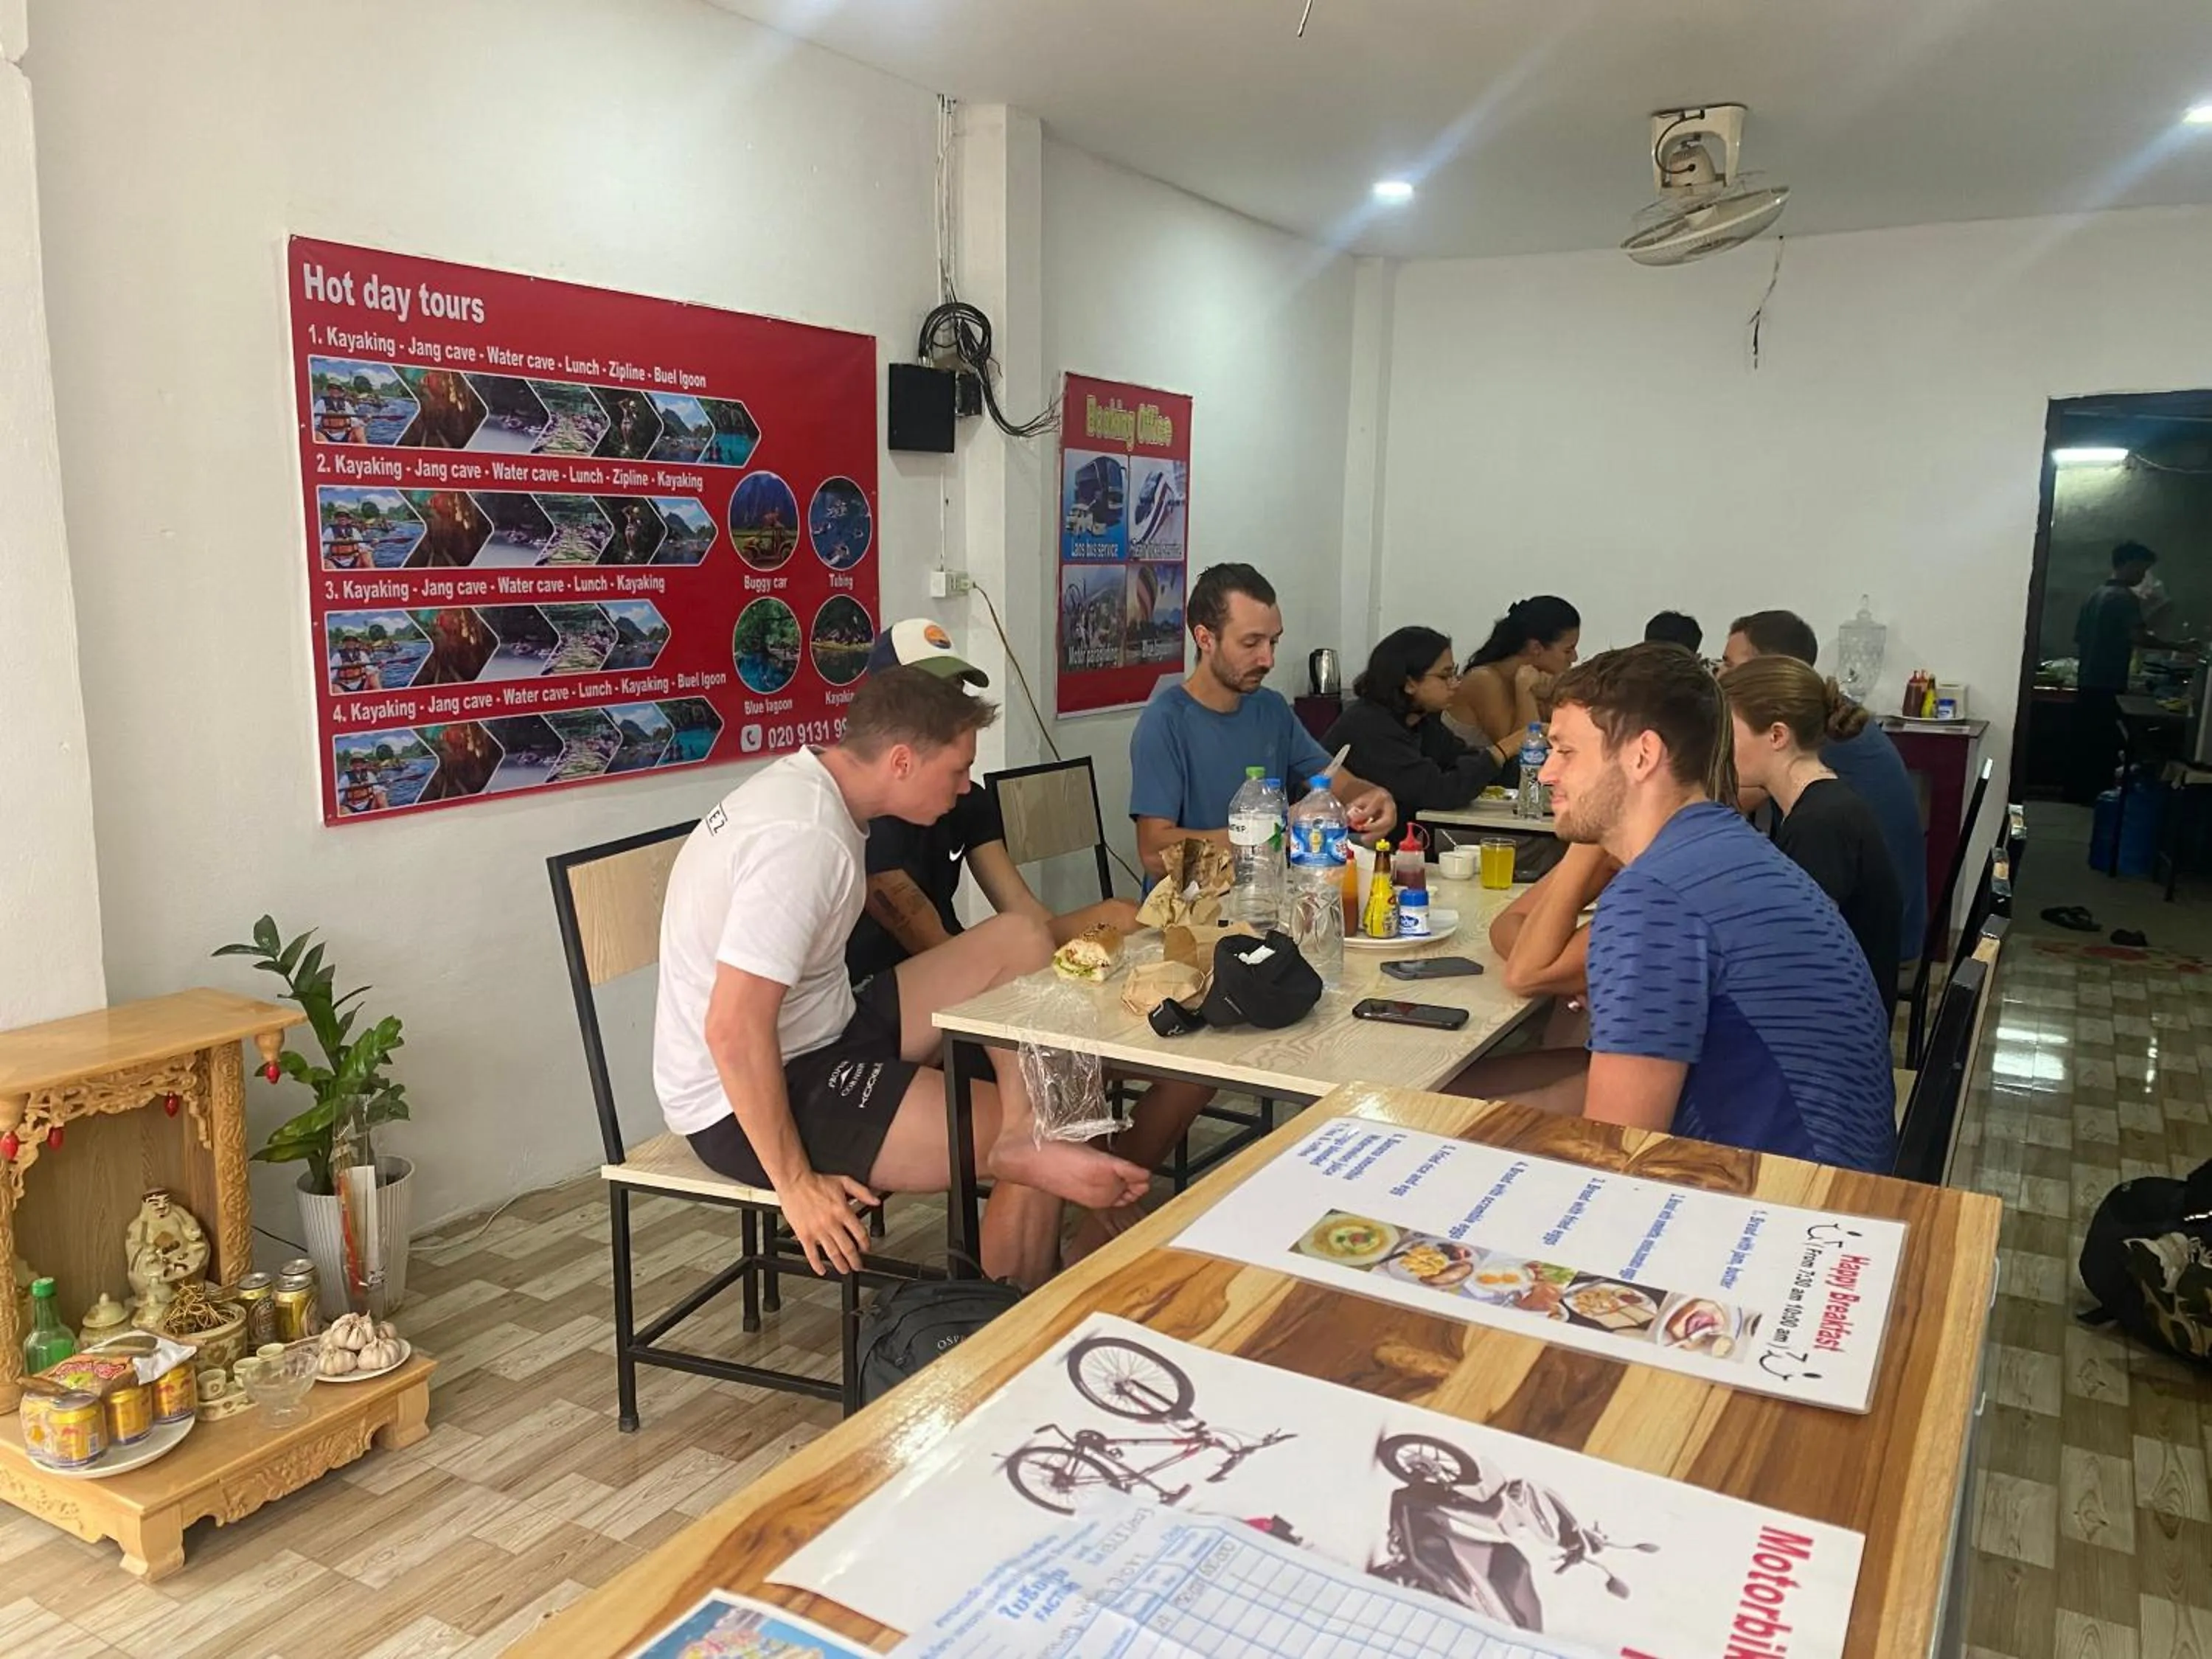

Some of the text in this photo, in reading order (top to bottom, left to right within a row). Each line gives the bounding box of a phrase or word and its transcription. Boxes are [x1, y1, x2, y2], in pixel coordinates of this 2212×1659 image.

[303, 262, 484, 323] Hot day tours
[308, 324, 322, 346] 1.
[327, 327, 395, 357] Kayaking
[408, 337, 441, 362] Jang
[445, 345, 476, 362] cave
[487, 347, 524, 367] Water
[527, 352, 555, 371] cave
[566, 356, 599, 375] Lunch
[609, 361, 645, 384] Zipline
[654, 367, 677, 385] Buel
[316, 454, 330, 473] 2.
[335, 456, 402, 479] Kayaking
[414, 459, 448, 481] Jang
[451, 465, 481, 479] cave
[492, 462, 528, 480] Water
[532, 467, 560, 482] cave
[568, 466, 603, 484] Lunch
[613, 468, 648, 488] Zipline
[657, 471, 703, 492] Kayaking
[325, 580, 338, 599] 3.
[343, 580, 409, 603] Kayaking
[421, 579, 453, 599] Jang
[457, 580, 487, 596] cave
[498, 576, 534, 594] Water
[537, 579, 564, 593] cave
[574, 575, 608, 591] Lunch
[616, 574, 664, 594] Kayaking
[744, 575, 788, 593] Buggy car
[829, 574, 854, 590] Tubing
[333, 705, 347, 723] 4.
[350, 700, 417, 725] Kayaking
[428, 695, 459, 715] Jang
[463, 693, 493, 709] cave
[503, 687, 538, 706] Water
[542, 686, 569, 702] cave
[578, 681, 612, 699] Lunch
[621, 675, 669, 697] Kayaking
[678, 672, 700, 689] Buel
[745, 698, 793, 715] Blue lagoon
[825, 690, 855, 706] Kayakin
[768, 726, 793, 748] 020
[797, 720, 830, 744] 9131
[1427, 1150, 1450, 1164] Fried
[1416, 1163, 1433, 1174] rice
[1500, 1166, 1524, 1184] Bread
[1404, 1173, 1422, 1186] and
[1488, 1183, 1506, 1196] with
[1577, 1183, 1601, 1202] Bread
[1568, 1201, 1584, 1214] with
[1448, 1223, 1470, 1239] eggs
[1743, 1216, 1765, 1236] Bread
[1542, 1229, 1563, 1245] eggs
[1736, 1237, 1753, 1251] with
[1801, 1248, 1822, 1267] From
[1719, 1266, 1743, 1289] butter
[1793, 1269, 1815, 1287] 7:30
[1788, 1287, 1804, 1301] am
[1813, 1253, 1871, 1352] Happy Breakfast
[1779, 1304, 1803, 1327] 10:00
[937, 1334, 967, 1350] OSP
[1773, 1328, 1790, 1342] am
